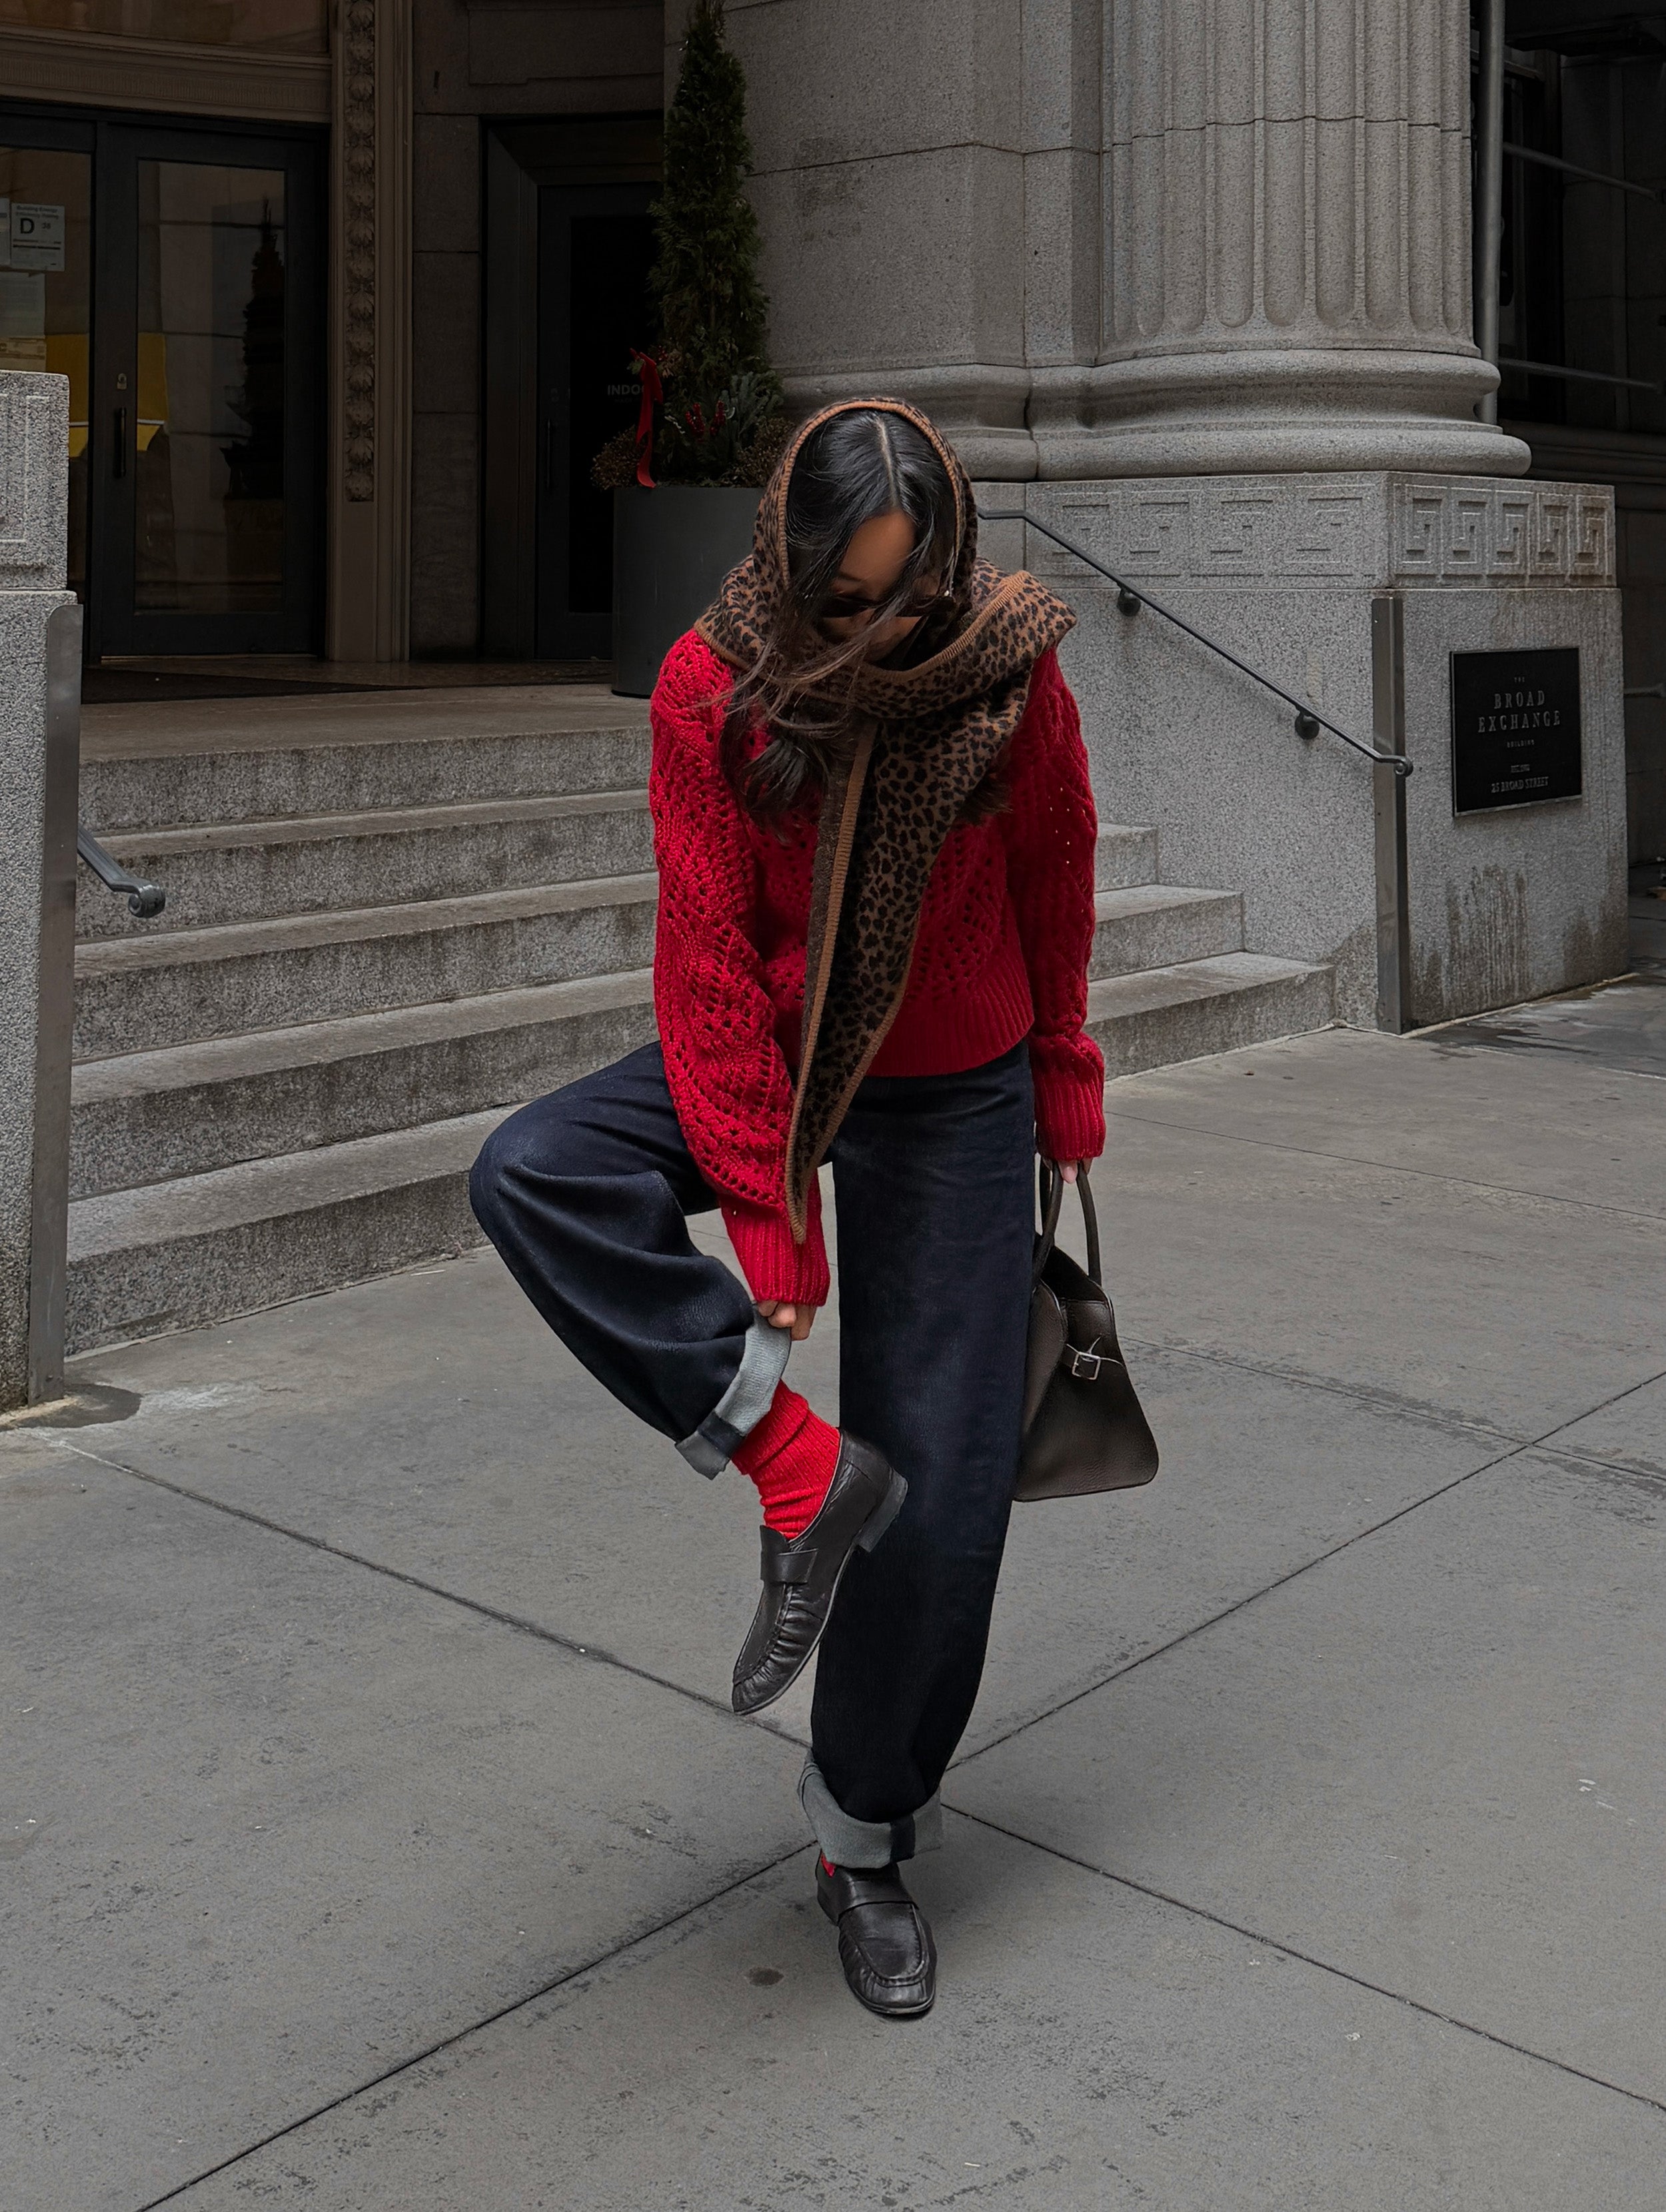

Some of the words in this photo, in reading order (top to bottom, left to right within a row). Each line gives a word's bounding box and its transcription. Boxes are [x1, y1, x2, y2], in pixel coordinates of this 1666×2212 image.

[21, 218, 34, 234] D
[1493, 690, 1545, 709] BROAD
[1478, 710, 1560, 732] EXCHANGE
[1491, 782, 1500, 793] 25
[1501, 779, 1524, 792] BROAD
[1525, 776, 1549, 789] STREET
